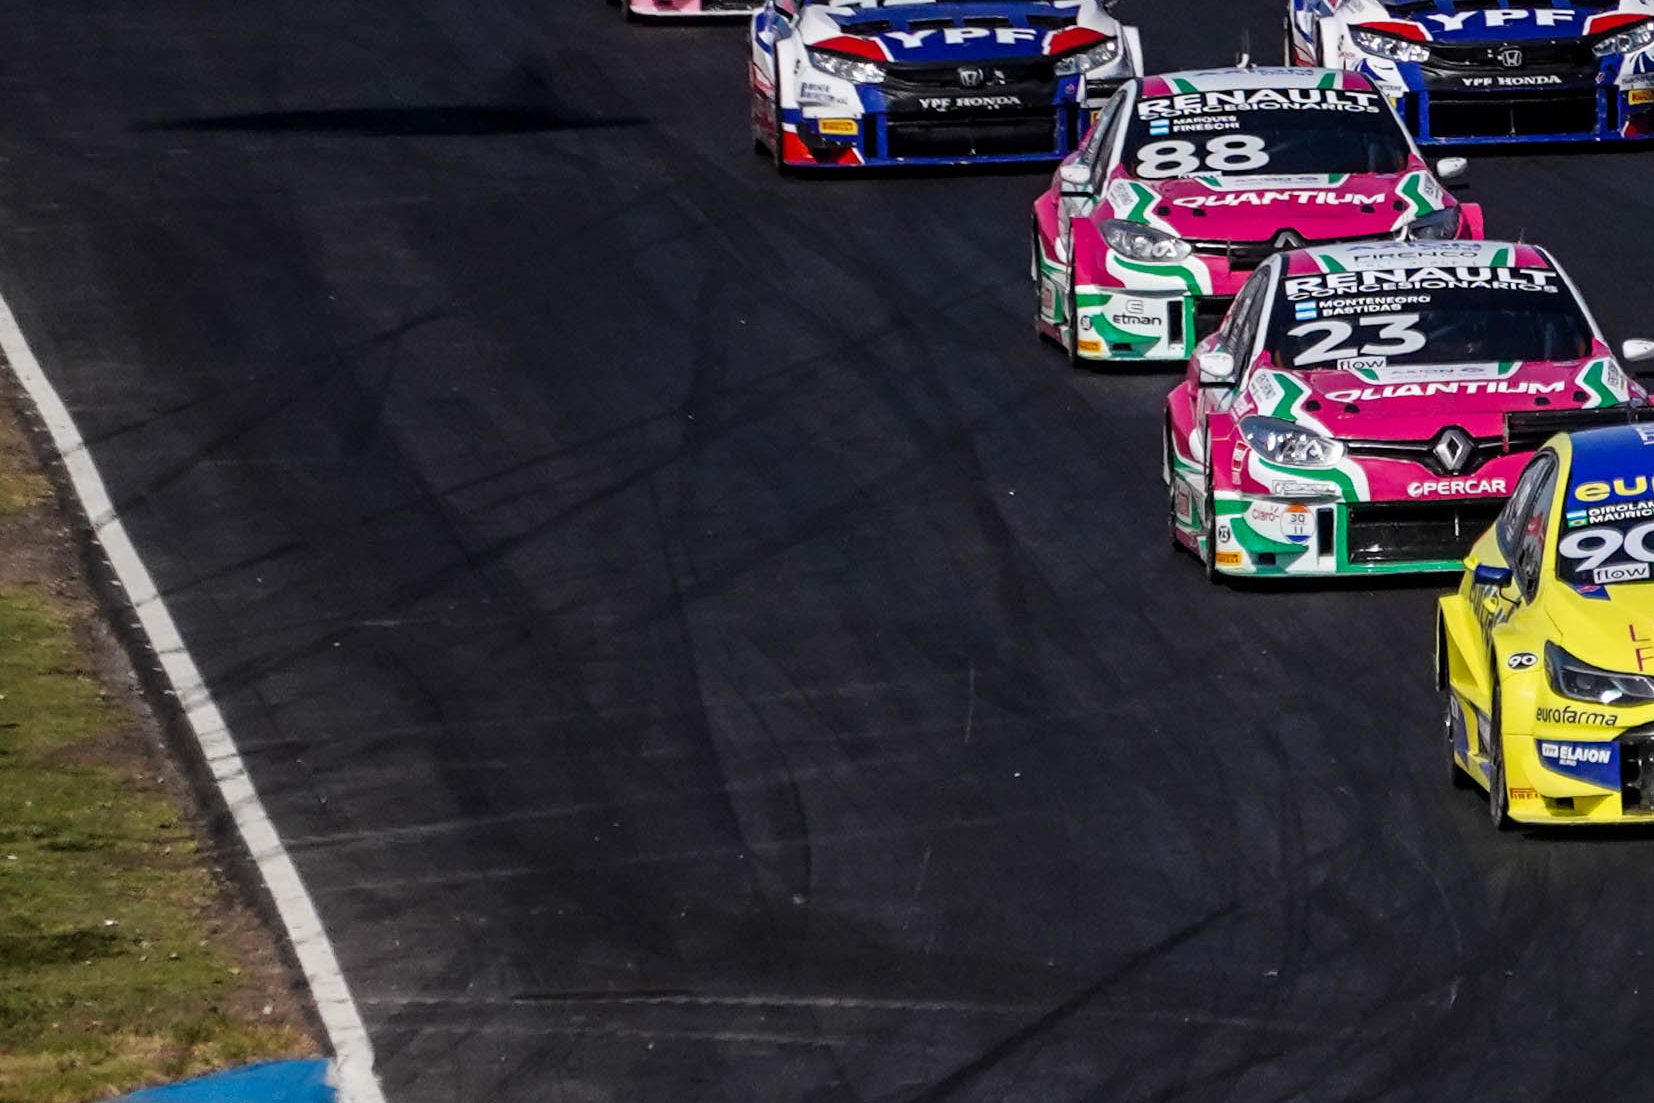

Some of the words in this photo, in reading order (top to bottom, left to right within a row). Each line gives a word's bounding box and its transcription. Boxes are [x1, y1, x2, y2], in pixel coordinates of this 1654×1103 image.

[1428, 9, 1576, 32] YPF
[885, 27, 1037, 49] YPF
[1461, 77, 1492, 87] YPF
[1497, 75, 1563, 86] HONDA
[918, 97, 951, 110] YPF
[953, 96, 1022, 108] HONDA
[1137, 89, 1379, 116] RENAULT
[1139, 101, 1381, 121] CONCESIONARIOS
[1172, 122, 1240, 133] FINESCHI
[1136, 134, 1270, 179] 88
[1173, 190, 1385, 208] QUANTIUM
[1353, 250, 1479, 262] FIRENCO
[1284, 267, 1558, 296] RENAULT
[1287, 278, 1560, 301] CONCESIONARIOS
[1319, 295, 1432, 309] MONTENEGRO
[1322, 303, 1402, 317] BASTIDAS
[1286, 312, 1427, 366] 23
[1339, 357, 1385, 370] flow
[1325, 381, 1566, 403] QUANTIUM
[1596, 567, 1648, 581] flow
[1508, 653, 1537, 668] 90
[1536, 705, 1619, 727] eurofarma
[1559, 745, 1612, 764] ELAION
